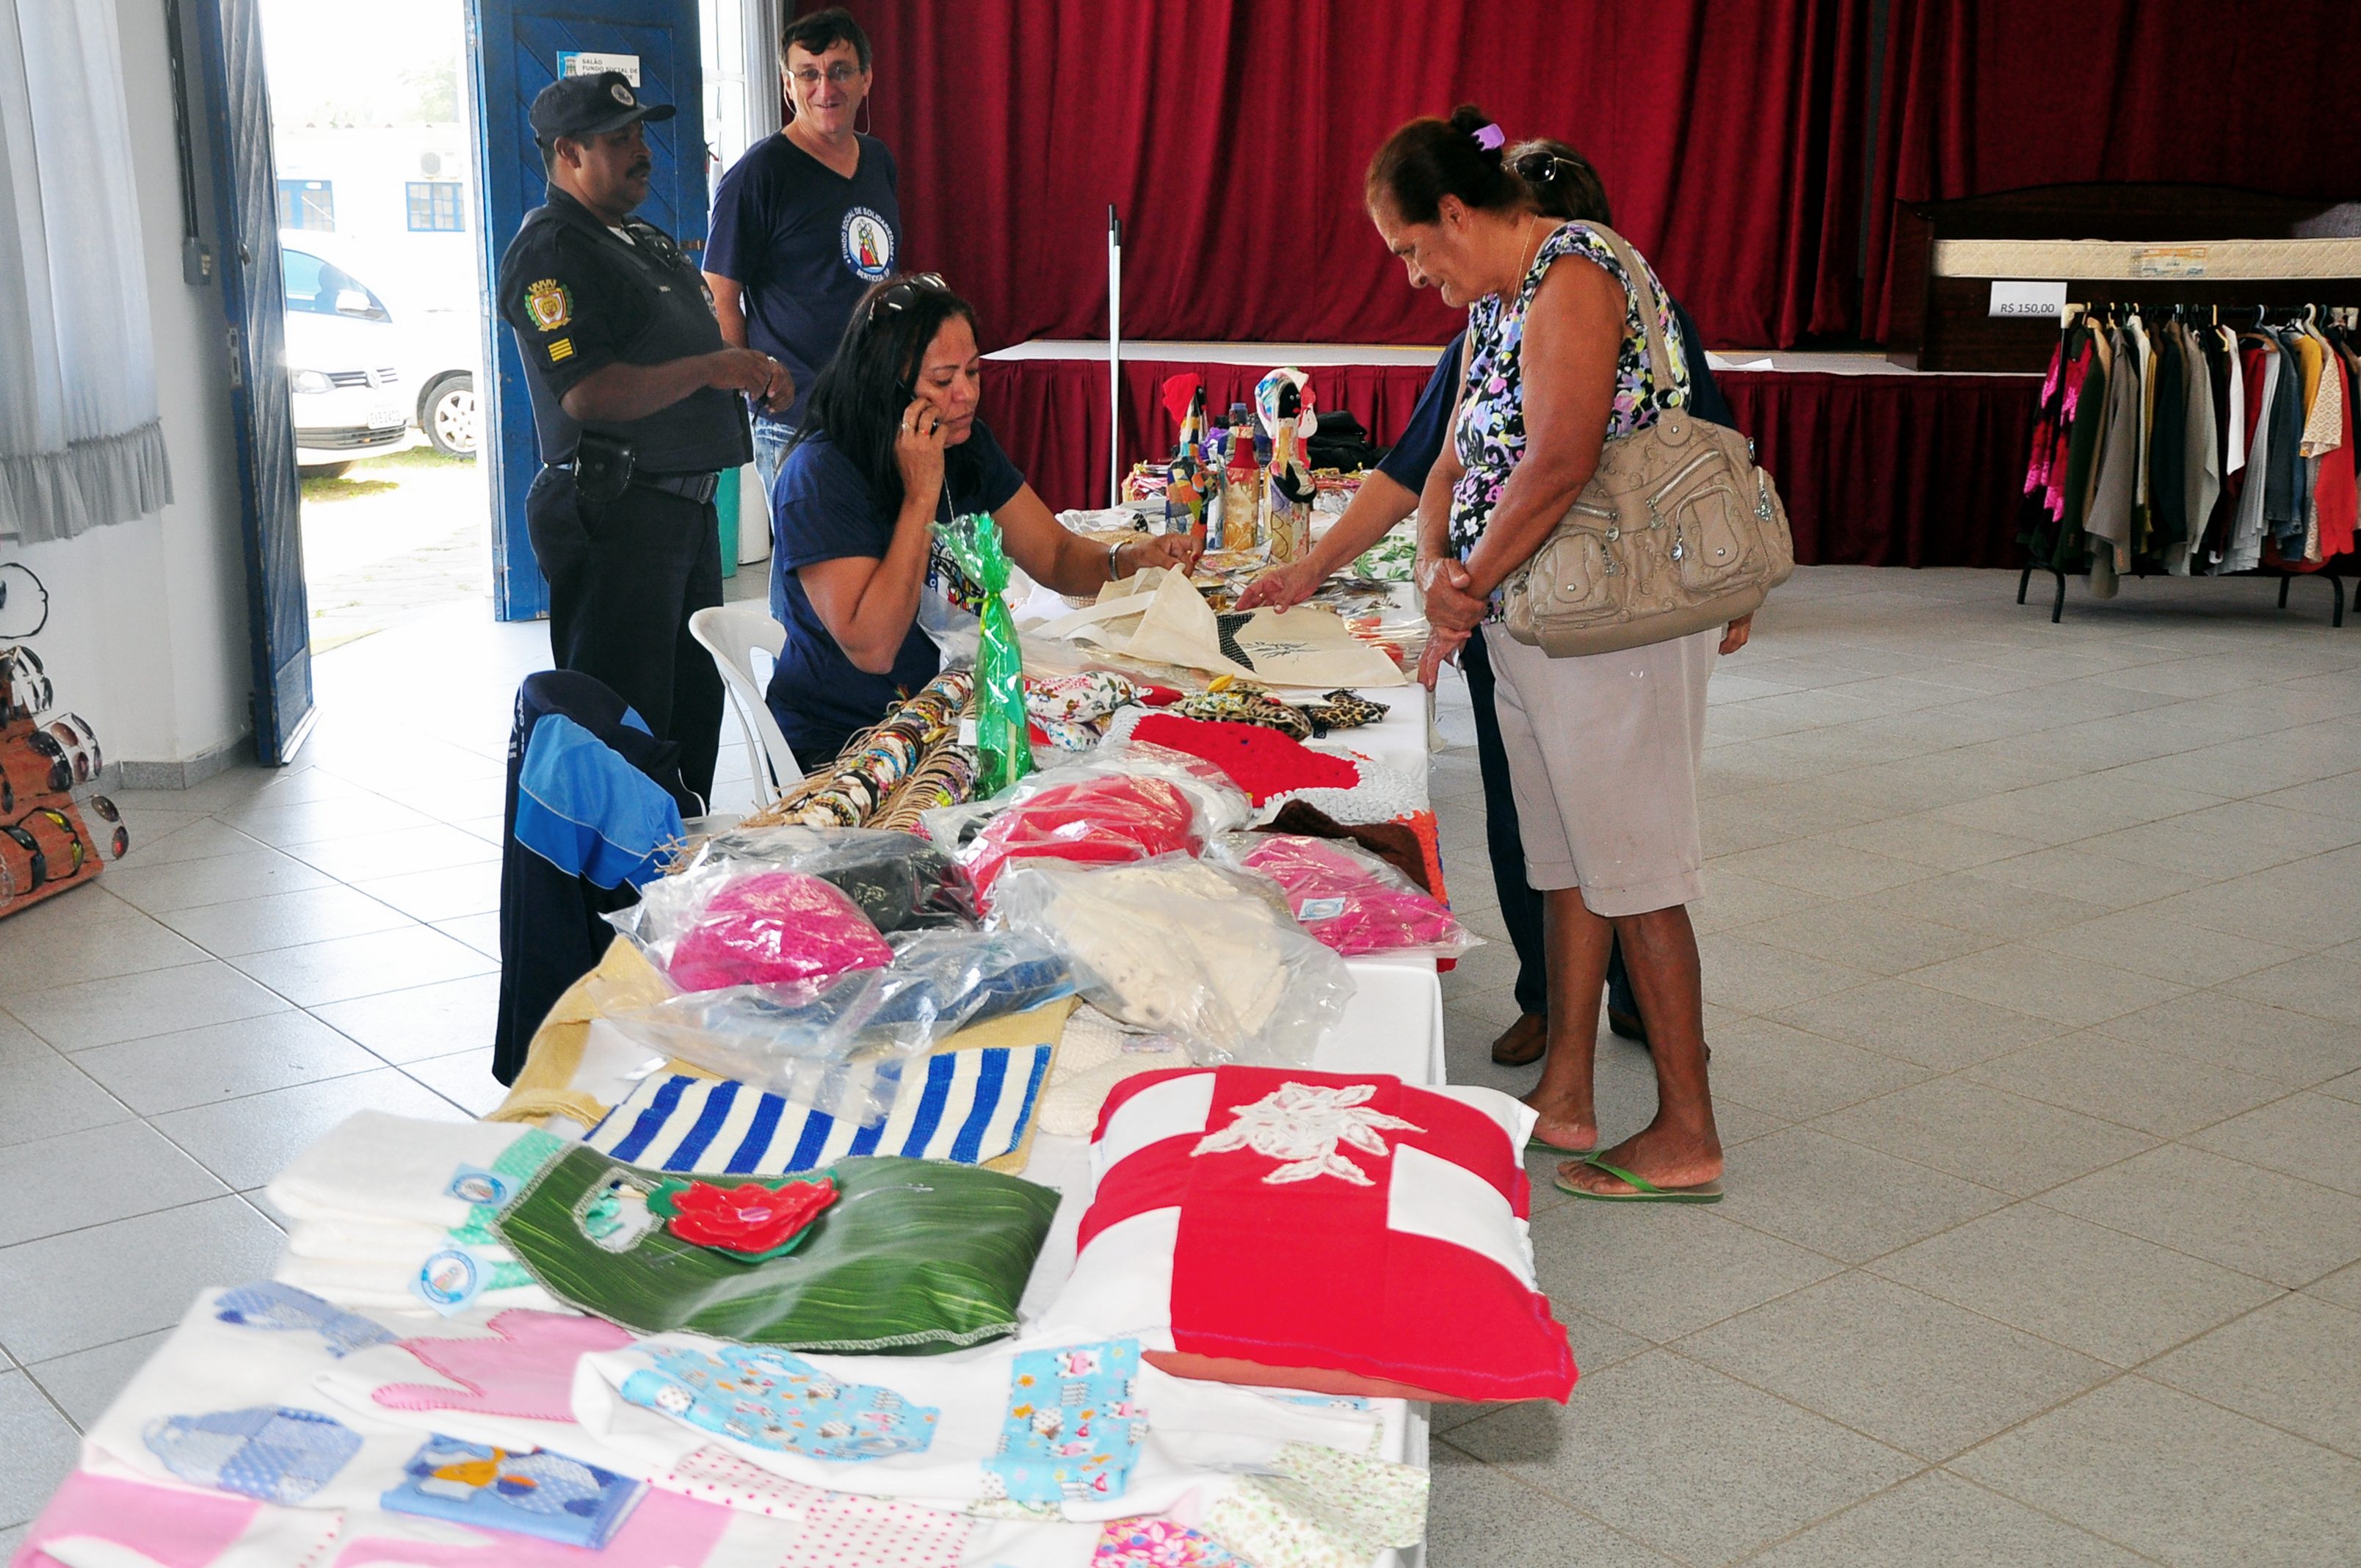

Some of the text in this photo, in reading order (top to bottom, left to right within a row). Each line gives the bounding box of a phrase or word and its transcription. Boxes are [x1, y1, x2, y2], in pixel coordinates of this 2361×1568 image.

[854, 206, 863, 215] DE
[842, 210, 856, 231] SOCIAL
[841, 232, 849, 259] FUNDO
[2000, 302, 2055, 314] R$ 150,00
